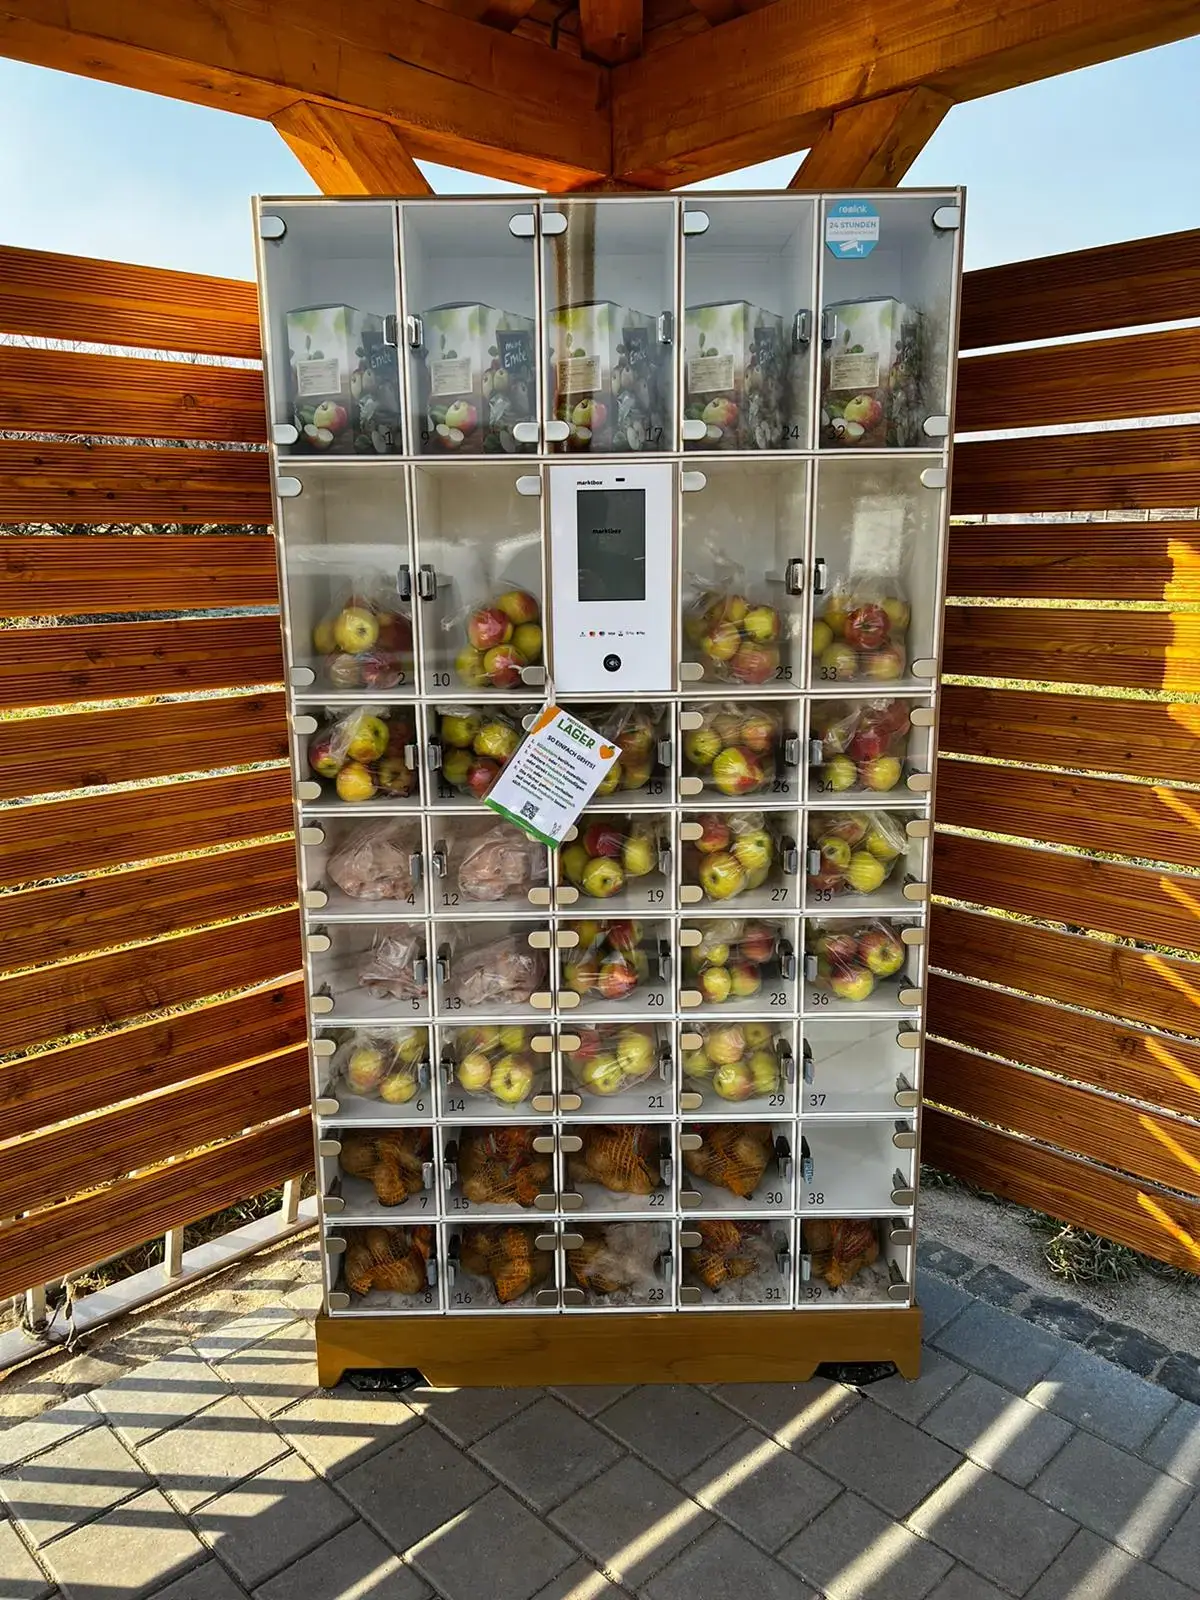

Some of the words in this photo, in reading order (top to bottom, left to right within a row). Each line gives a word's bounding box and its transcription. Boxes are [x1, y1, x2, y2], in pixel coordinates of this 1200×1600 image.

[421, 431, 429, 445] 9
[646, 428, 663, 442] 17
[782, 426, 799, 440] 24
[828, 425, 845, 439] 32
[385, 432, 393, 445] 1
[398, 672, 405, 685] 2
[776, 667, 792, 679] 25
[820, 667, 836, 680] 33
[433, 673, 450, 686] 10
[556, 718, 596, 749] LAGER
[546, 734, 555, 743] SO
[554, 740, 577, 757] EINFACH
[576, 754, 595, 770] GEHTS!
[438, 786, 454, 798] 11
[647, 782, 663, 794] 18
[773, 781, 789, 792] 26
[817, 780, 833, 792] 34
[407, 893, 415, 905] 4
[443, 894, 459, 905] 12
[648, 890, 664, 902] 19
[772, 889, 788, 901] 27
[815, 889, 831, 901] 35
[412, 999, 419, 1009] 5
[445, 997, 461, 1009] 13
[648, 994, 664, 1006] 20
[770, 993, 786, 1005] 28
[812, 993, 828, 1005] 36
[417, 1099, 424, 1111] 6
[449, 1100, 465, 1111] 14
[648, 1096, 664, 1108] 21
[769, 1095, 785, 1106] 29
[810, 1094, 826, 1106] 37
[420, 1198, 428, 1208] 7
[453, 1197, 469, 1209] 15
[649, 1195, 664, 1206] 22
[767, 1192, 783, 1203] 30
[808, 1193, 824, 1204] 38
[425, 1293, 432, 1303] 8
[456, 1292, 471, 1303] 16
[649, 1289, 664, 1300] 23
[766, 1288, 781, 1299] 31
[807, 1287, 821, 1298] 39
